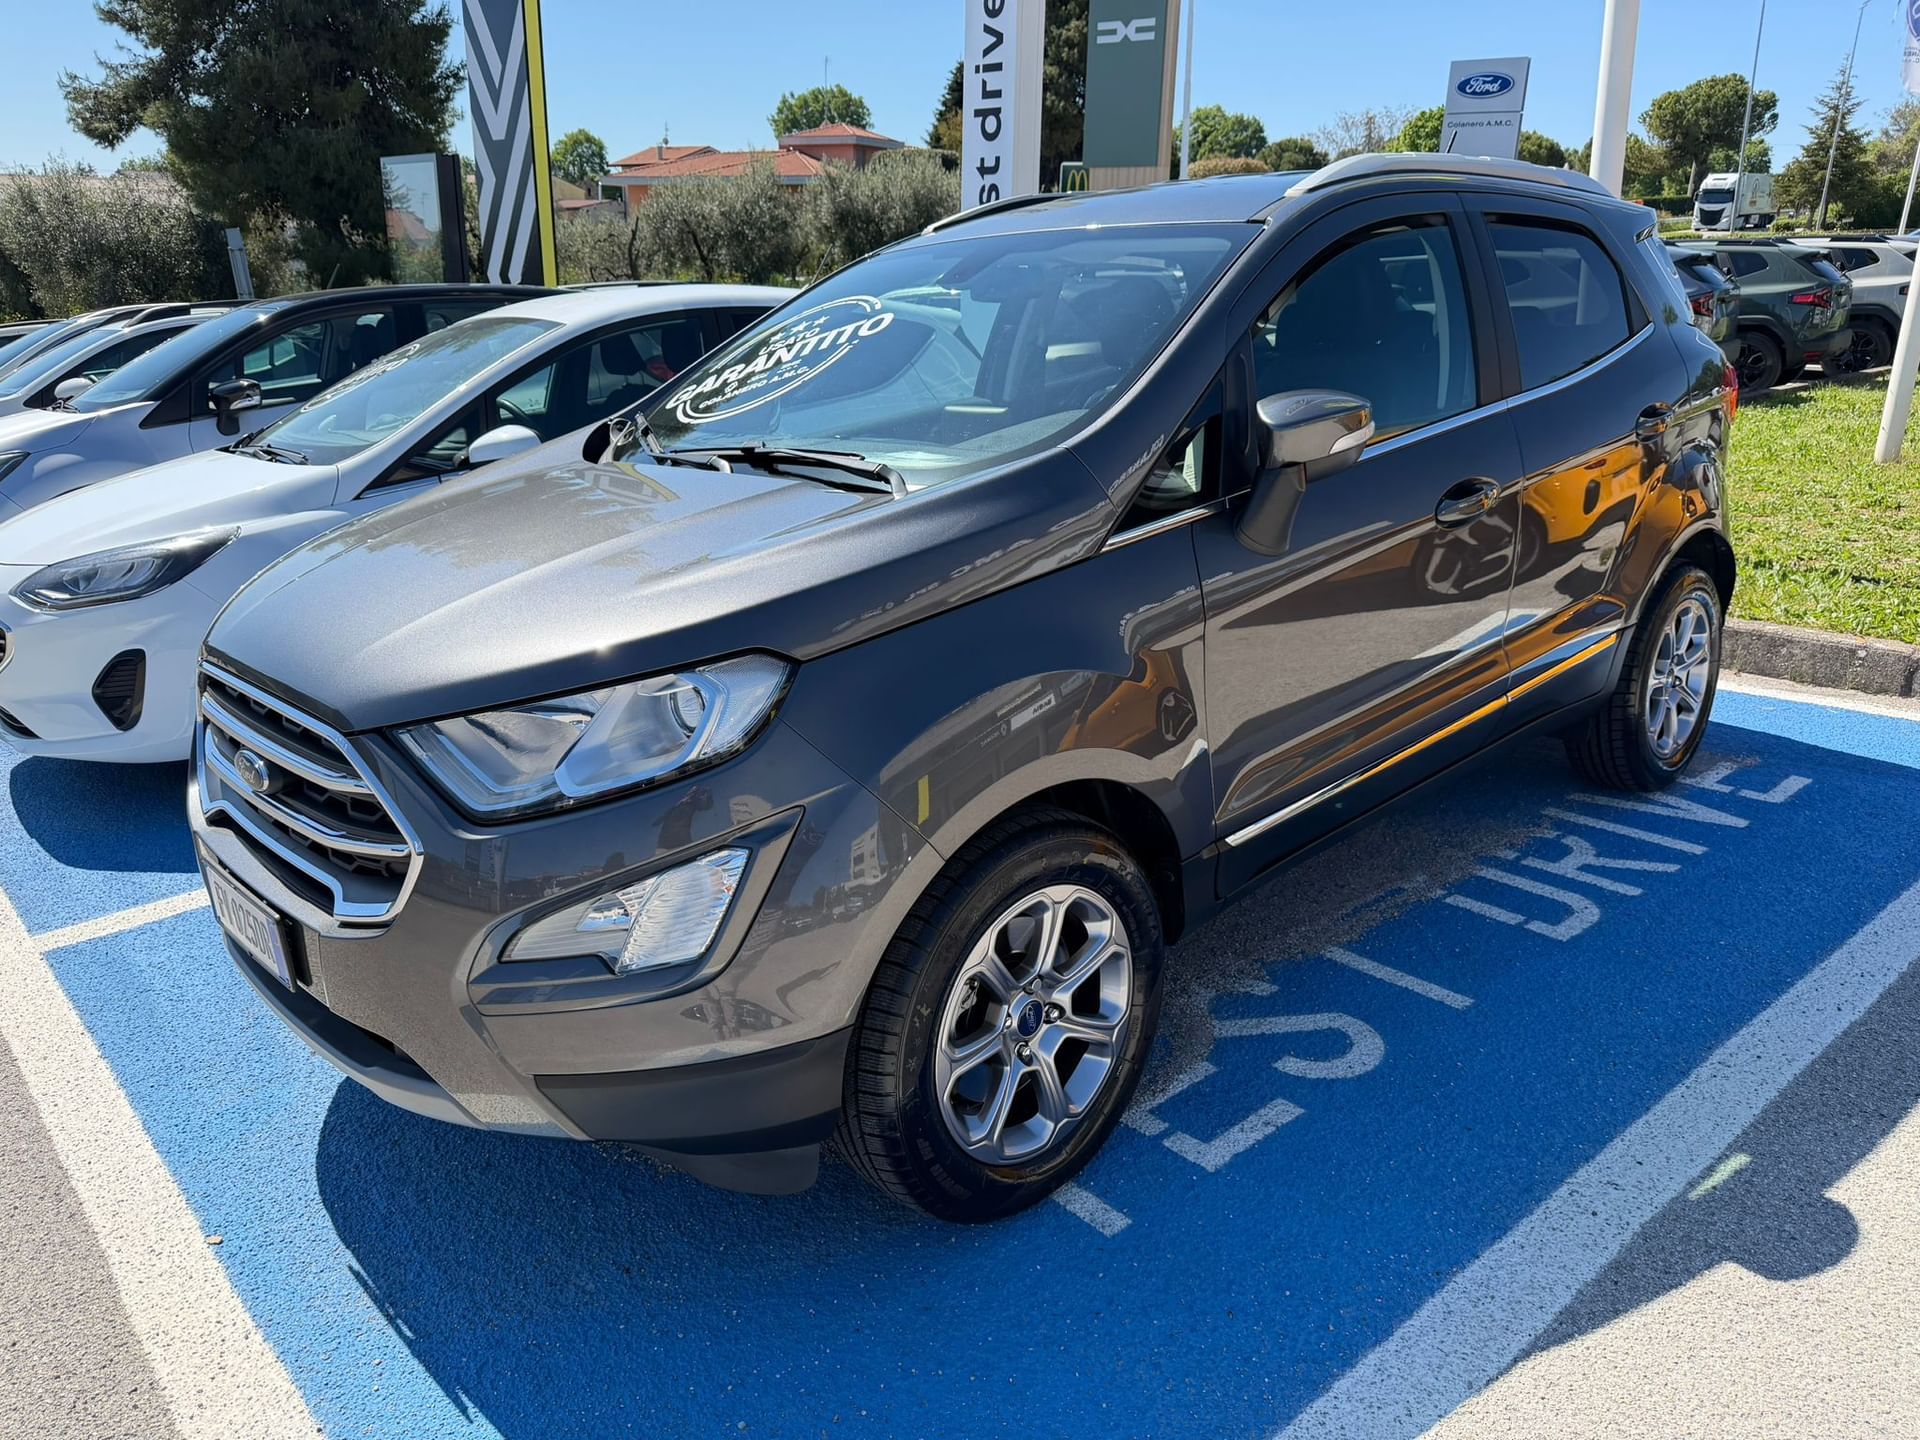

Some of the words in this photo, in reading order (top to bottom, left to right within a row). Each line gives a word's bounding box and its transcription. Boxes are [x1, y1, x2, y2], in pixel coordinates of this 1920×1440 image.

[1466, 76, 1502, 93] Ford
[1447, 121, 1485, 129] Colanero
[759, 327, 821, 356] USATO
[665, 312, 895, 409] GARANTITO
